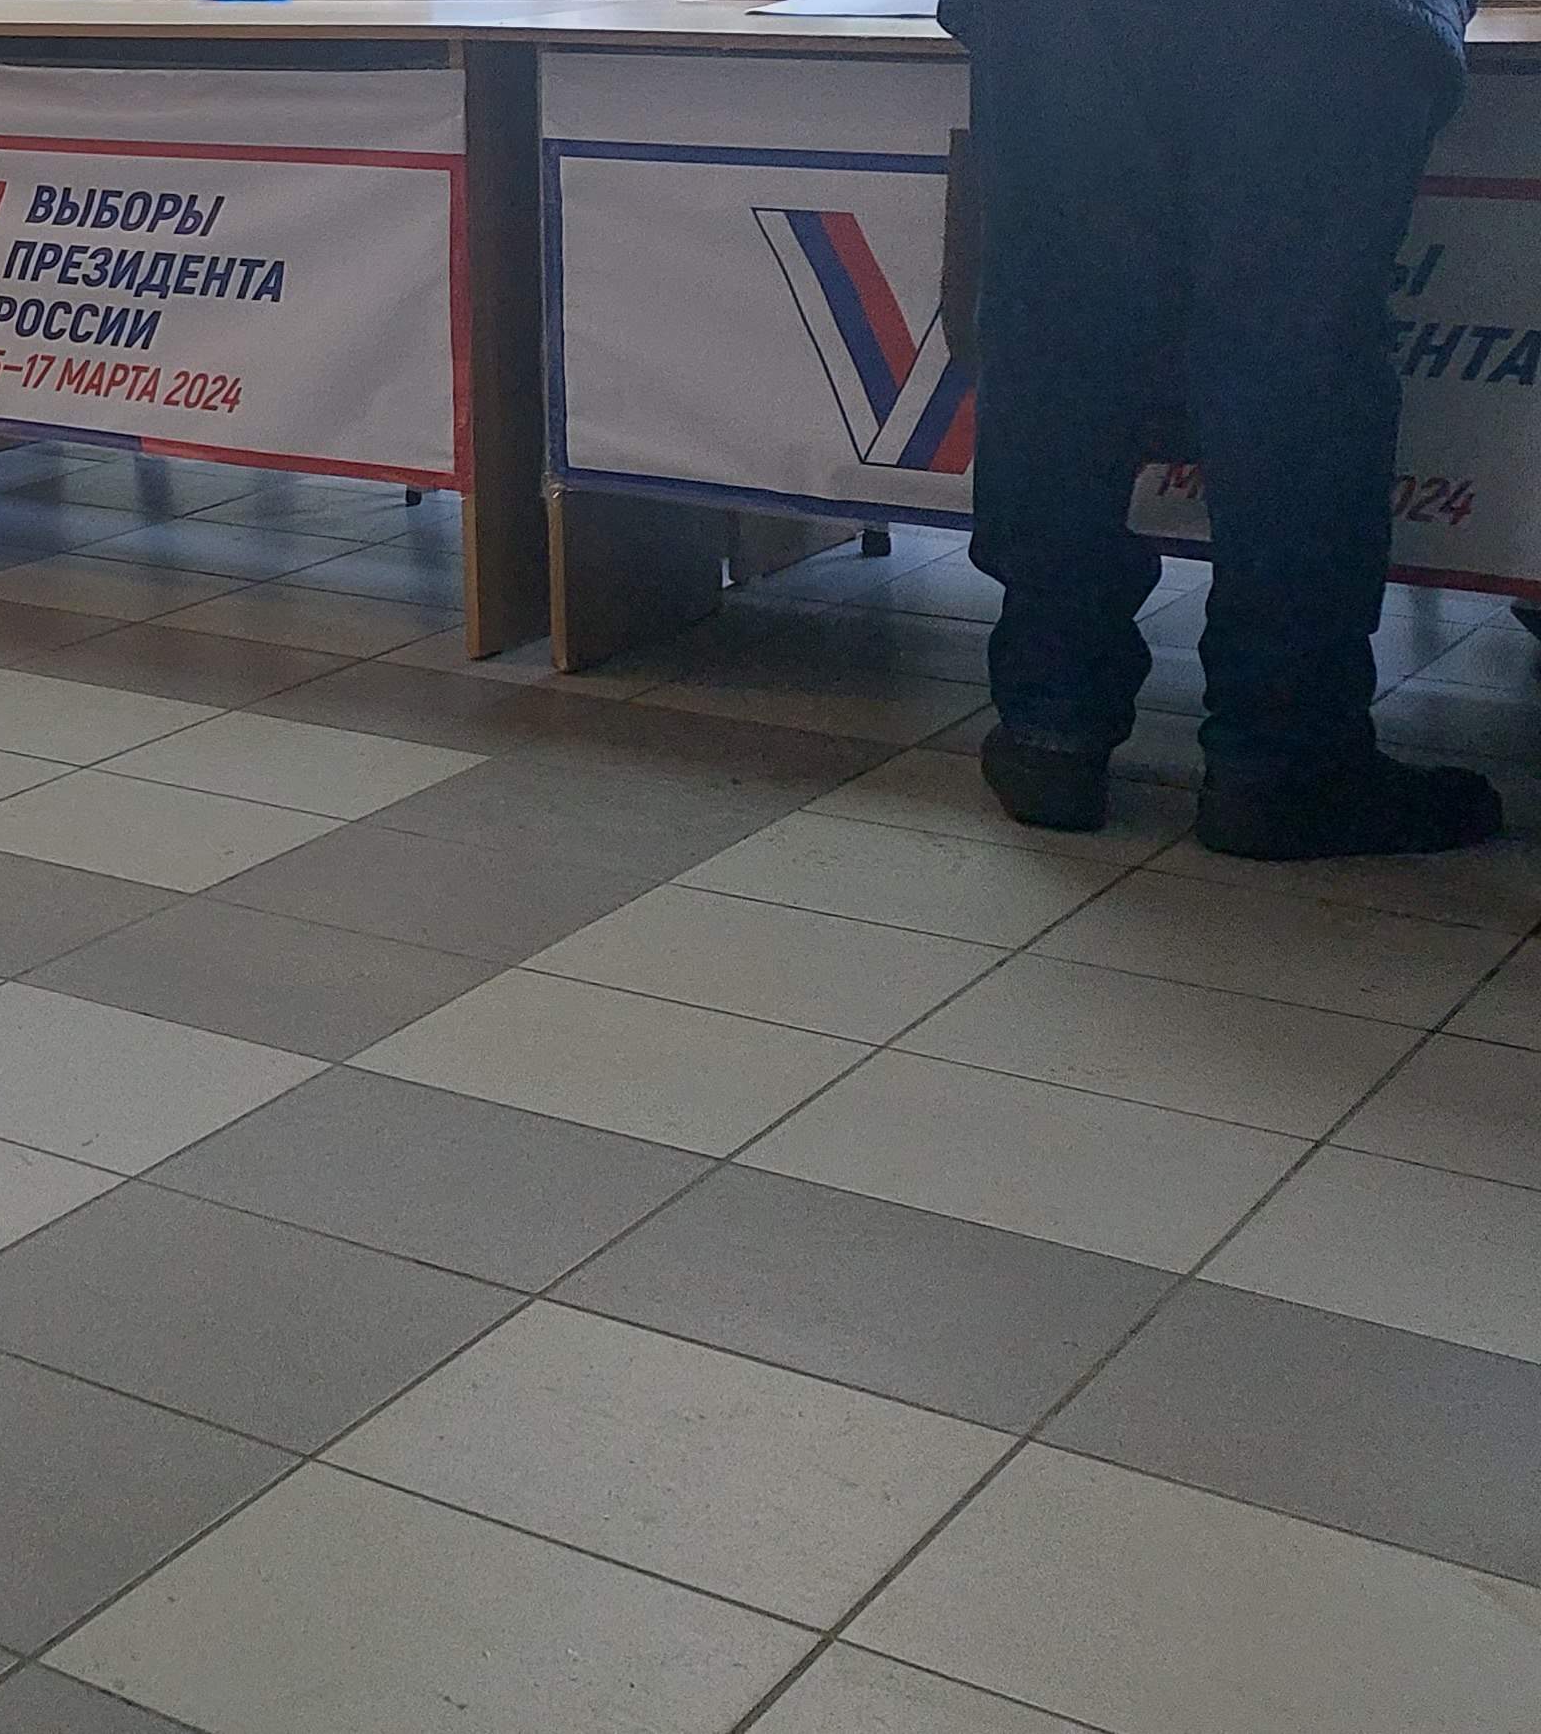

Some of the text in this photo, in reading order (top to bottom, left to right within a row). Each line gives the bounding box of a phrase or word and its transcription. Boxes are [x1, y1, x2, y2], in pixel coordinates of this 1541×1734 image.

[26, 184, 224, 238] ВЫБОРЫ
[2, 240, 287, 304] ПРЕЗИДЕНТА
[55, 358, 161, 405] МАРТА
[163, 370, 244, 415] 2024
